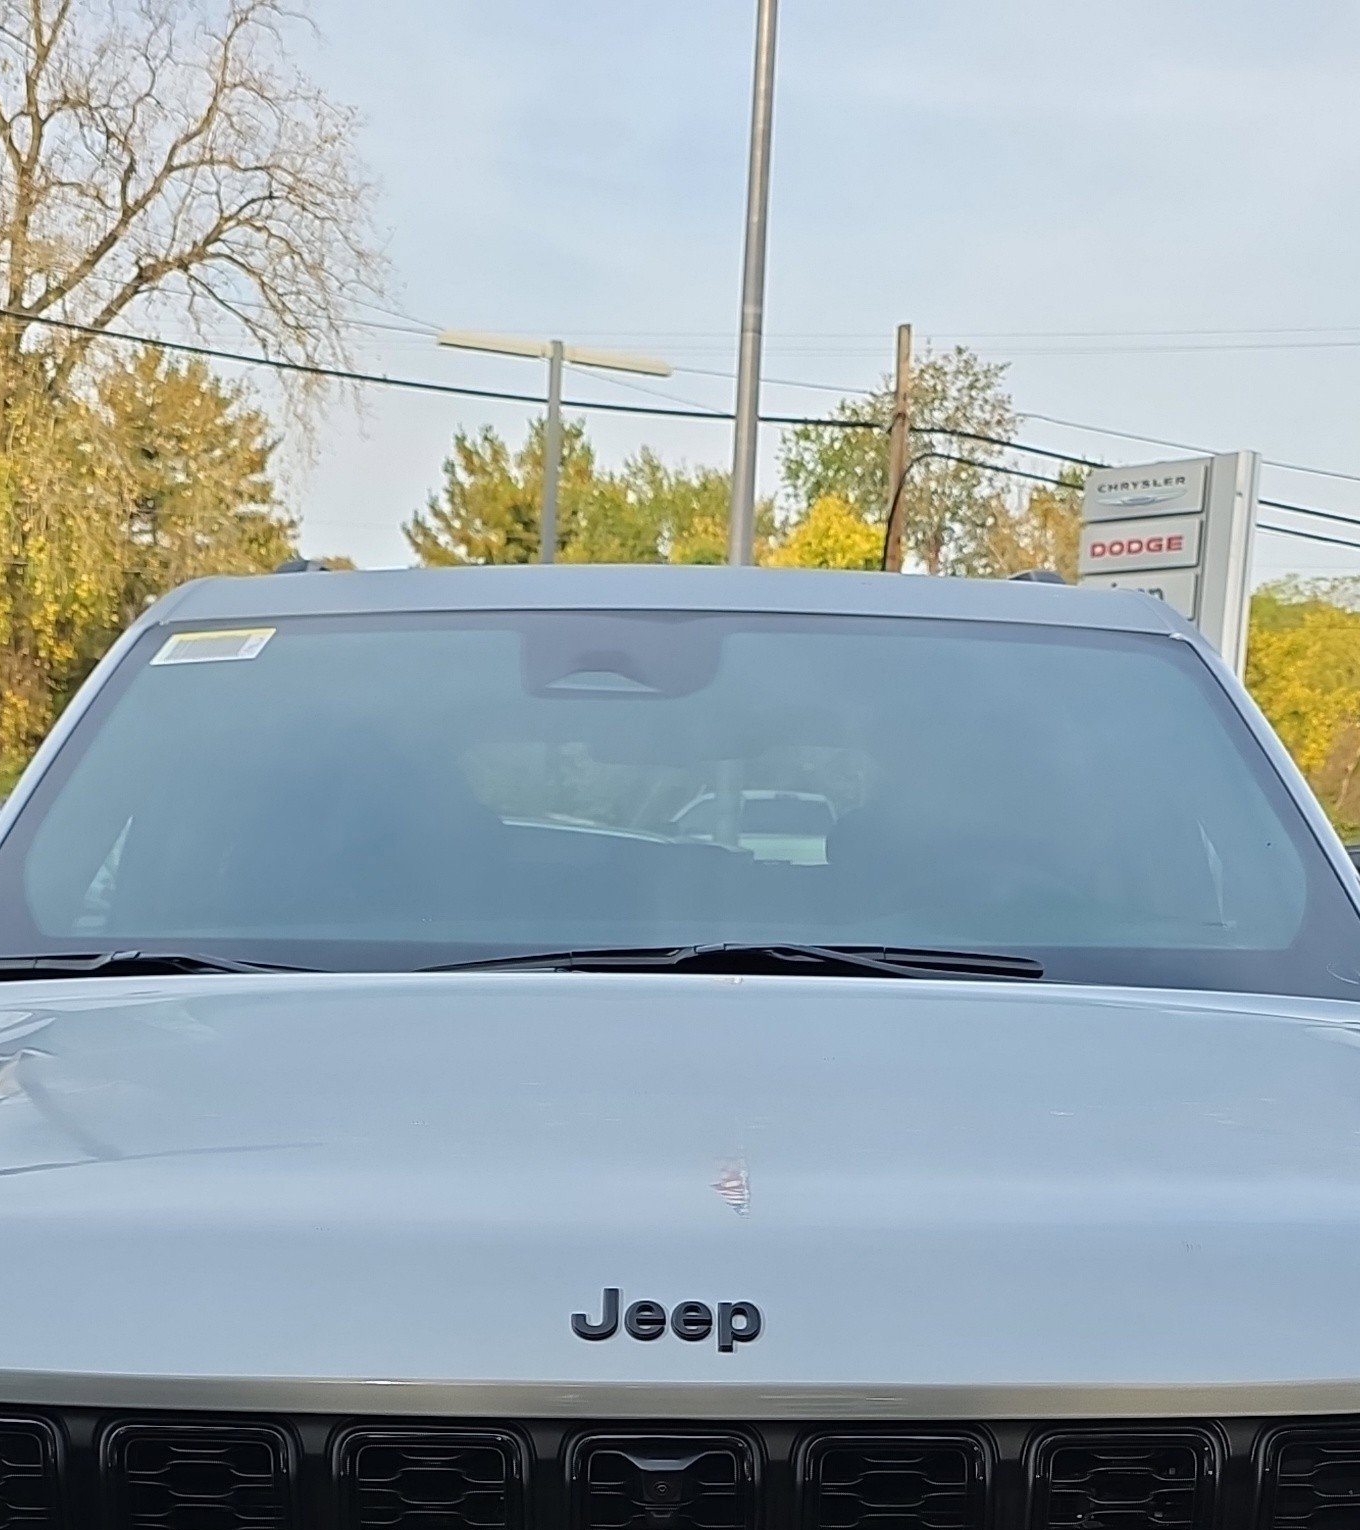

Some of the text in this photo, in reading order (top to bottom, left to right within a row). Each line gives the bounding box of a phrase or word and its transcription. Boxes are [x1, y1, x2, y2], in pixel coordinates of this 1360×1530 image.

[1096, 475, 1187, 494] CHRYSLER
[1090, 535, 1184, 559] DODGE
[570, 1287, 763, 1353] Jeep
